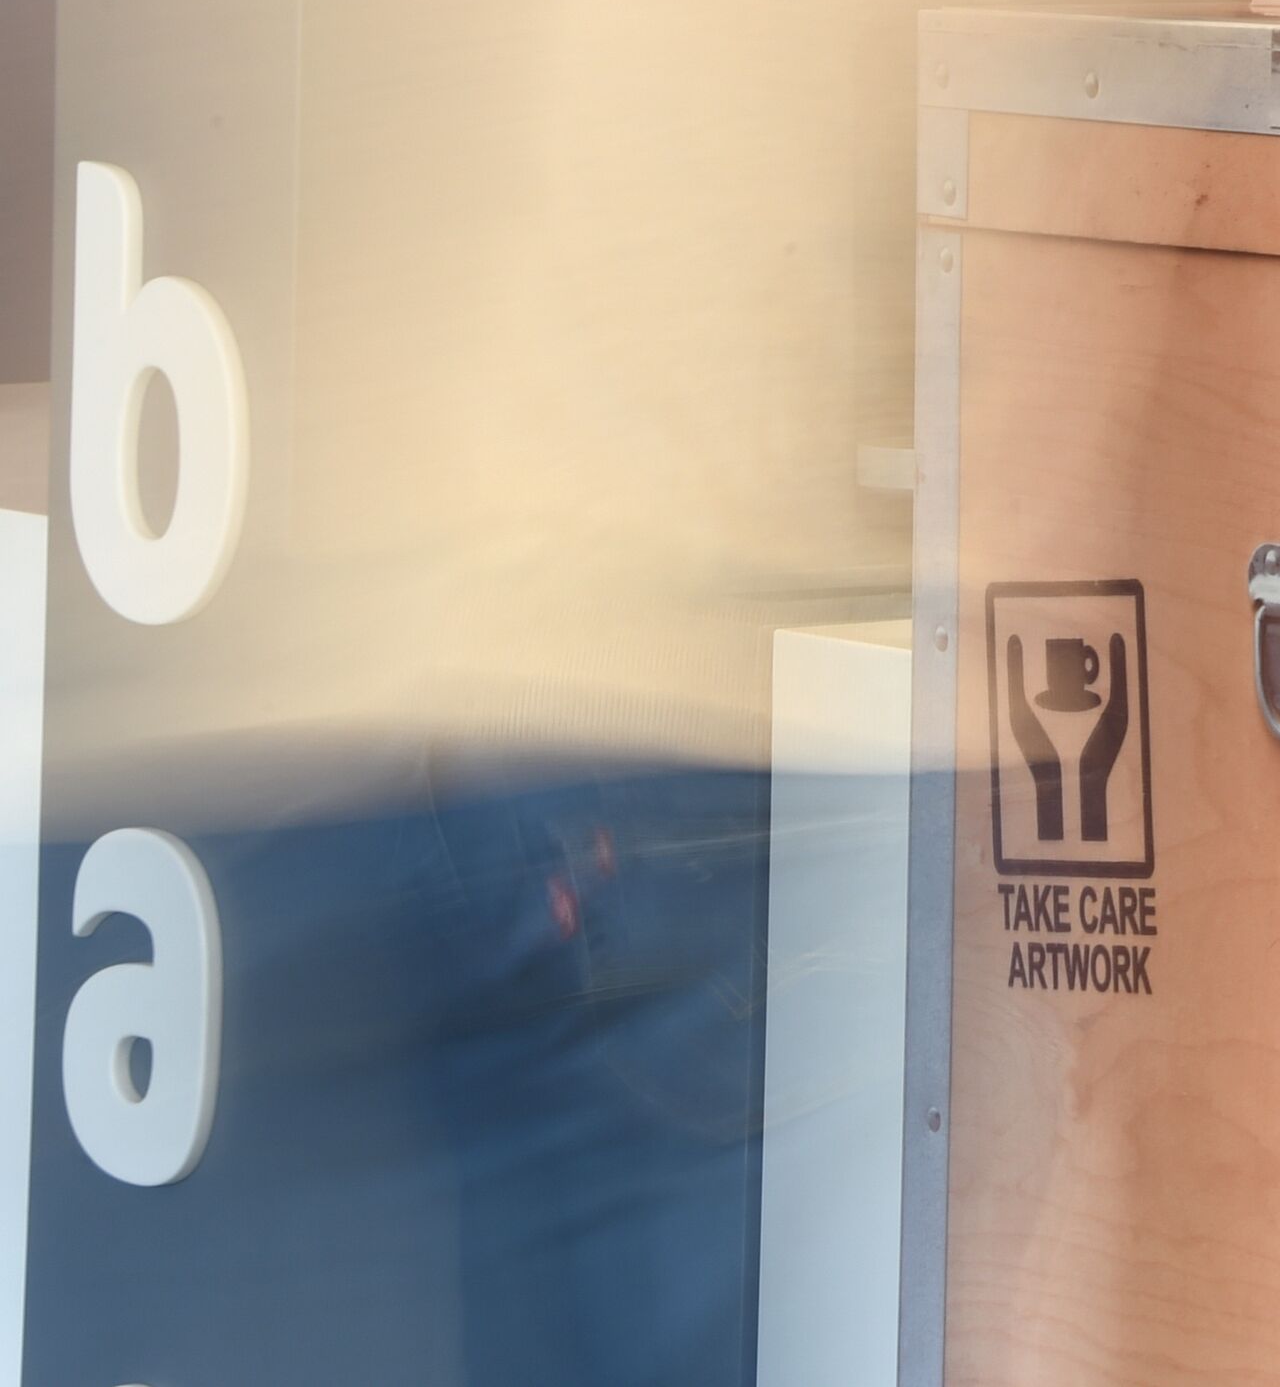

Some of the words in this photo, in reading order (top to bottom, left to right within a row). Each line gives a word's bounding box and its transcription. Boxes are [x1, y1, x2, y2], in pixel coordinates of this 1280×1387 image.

[998, 883, 1071, 932] TAKE
[1079, 885, 1157, 936] CARE
[1008, 942, 1152, 994] ARTWORK
